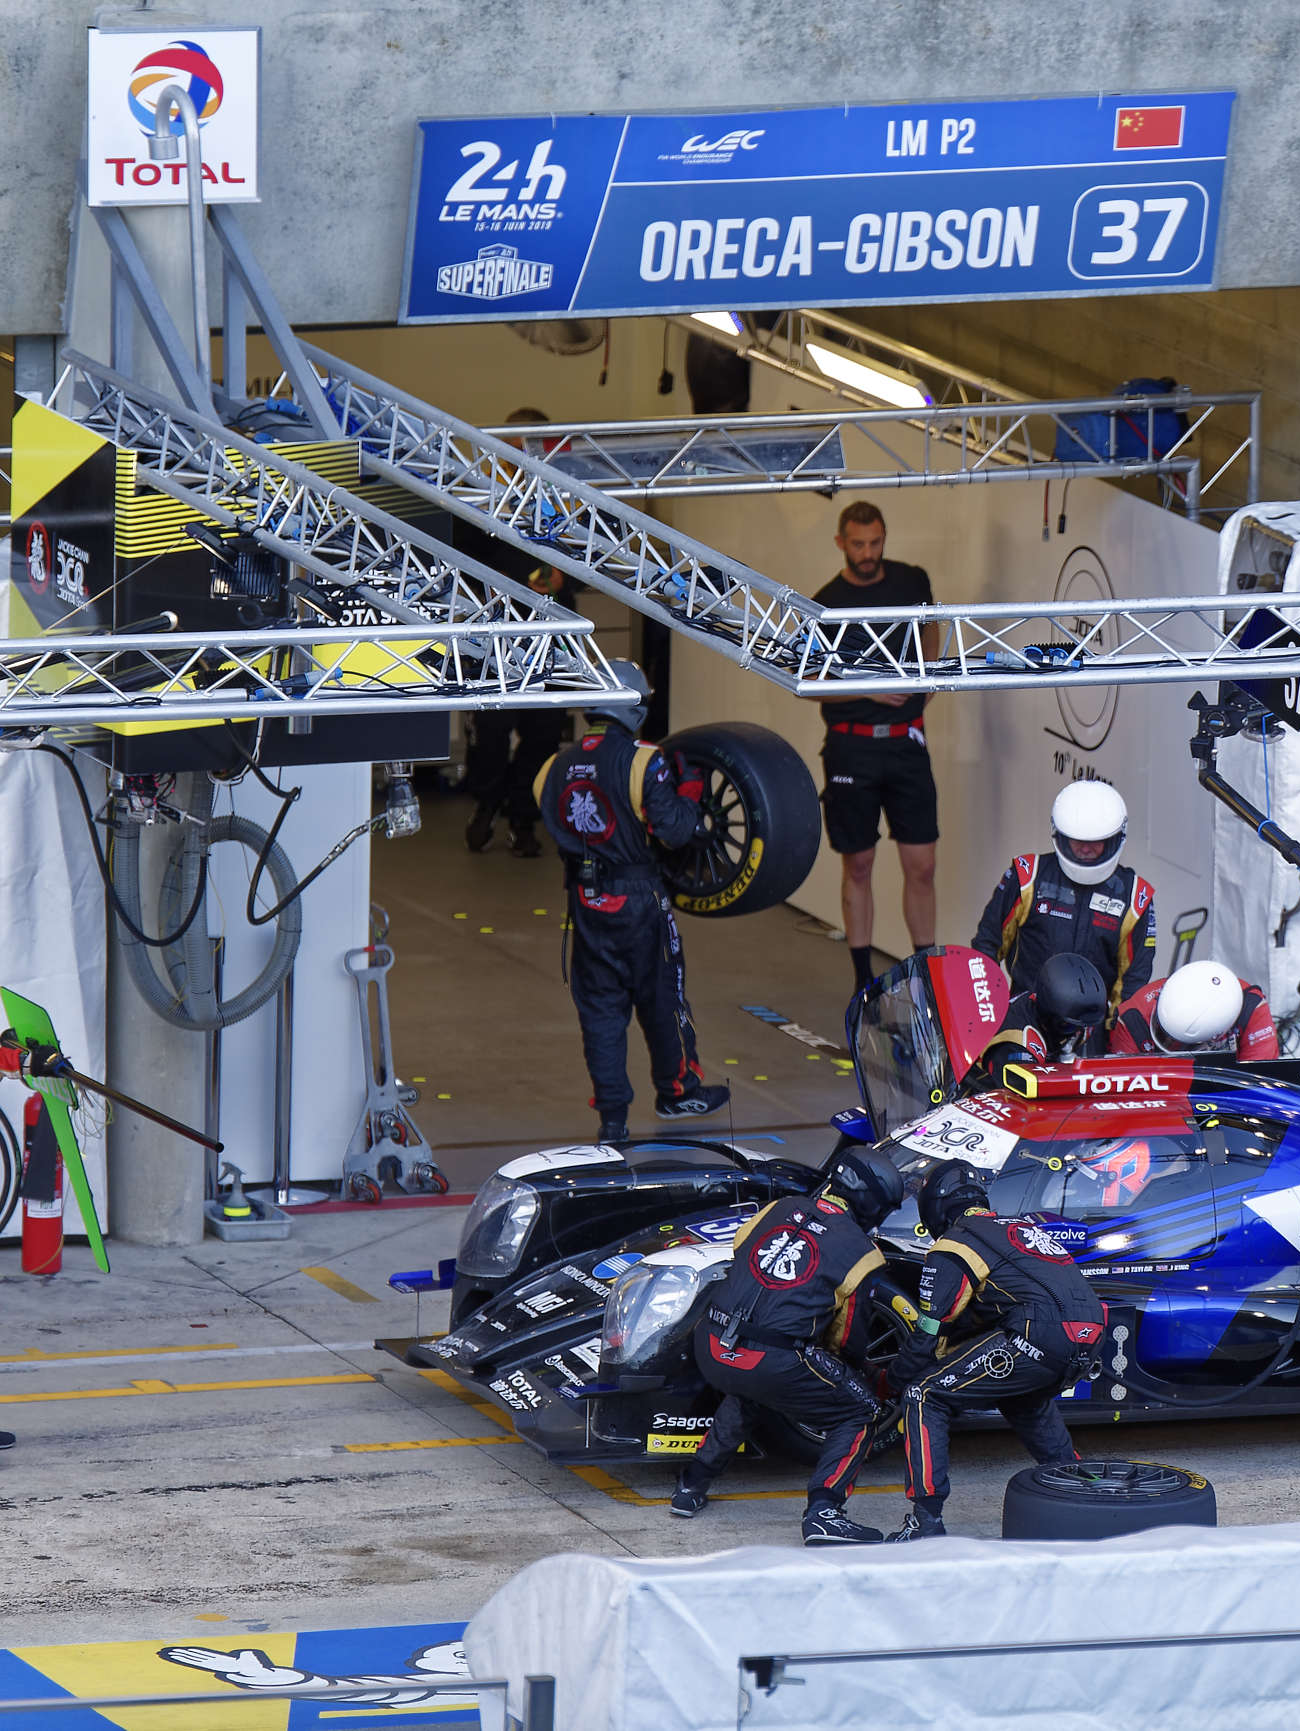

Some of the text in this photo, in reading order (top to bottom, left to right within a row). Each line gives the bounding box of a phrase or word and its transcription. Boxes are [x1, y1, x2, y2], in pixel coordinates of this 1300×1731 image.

[681, 130, 766, 153] WEC
[886, 118, 976, 157] LM P2
[105, 157, 246, 187] TOTAL
[445, 139, 567, 202] 24h
[439, 203, 557, 222] LE MANS
[502, 221, 525, 232] JUIN
[639, 204, 1040, 283] ORECA-GIBSON
[1090, 196, 1189, 266] 37
[438, 258, 552, 298] SUPERFINALE
[1071, 1073, 1170, 1095] TOTAL
[912, 1138, 950, 1155] JOTA
[1049, 1227, 1086, 1241] ezolve
[507, 1370, 544, 1409] TOTAL
